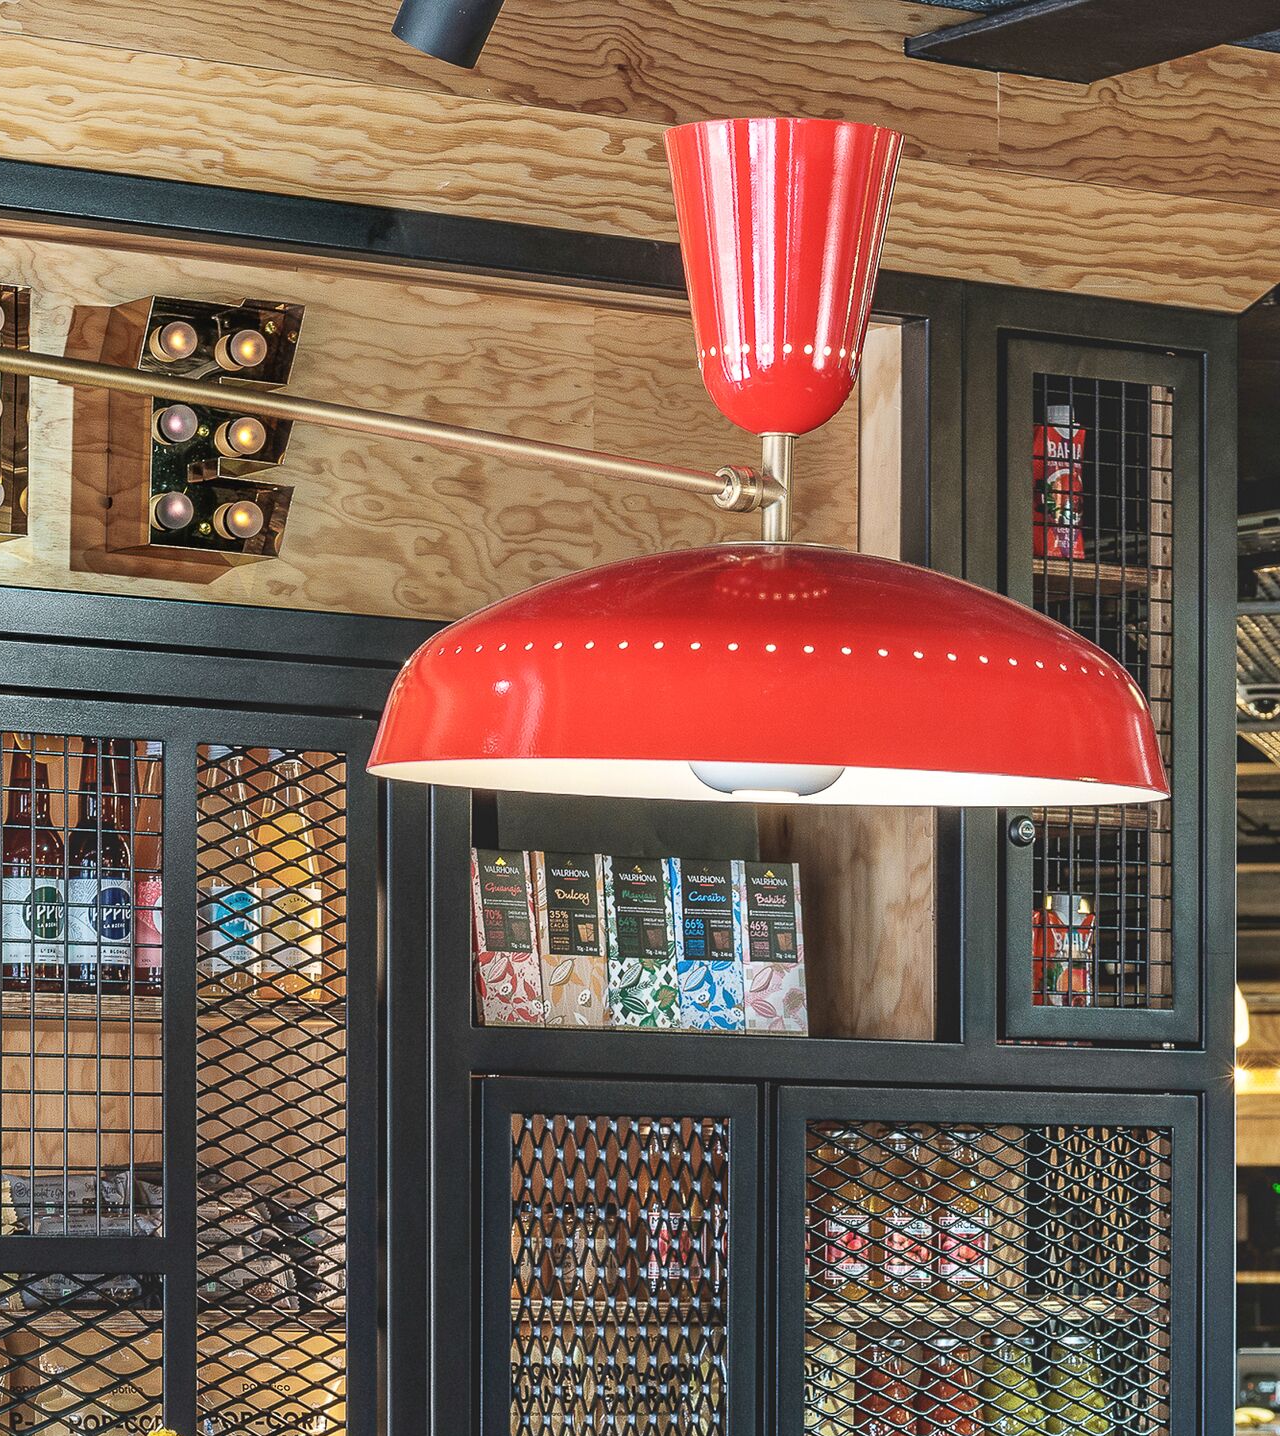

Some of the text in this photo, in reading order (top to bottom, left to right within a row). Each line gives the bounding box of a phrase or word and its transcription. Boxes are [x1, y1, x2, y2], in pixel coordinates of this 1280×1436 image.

[484, 865, 520, 875] VALRHONA
[551, 868, 590, 878] VALRHONA
[619, 873, 658, 883] VALRHONA
[687, 874, 726, 884] VALRHONA
[751, 877, 788, 887] VALRHONA
[549, 910, 569, 919] 35%
[684, 918, 704, 929] 66%
[749, 920, 768, 931] 46%
